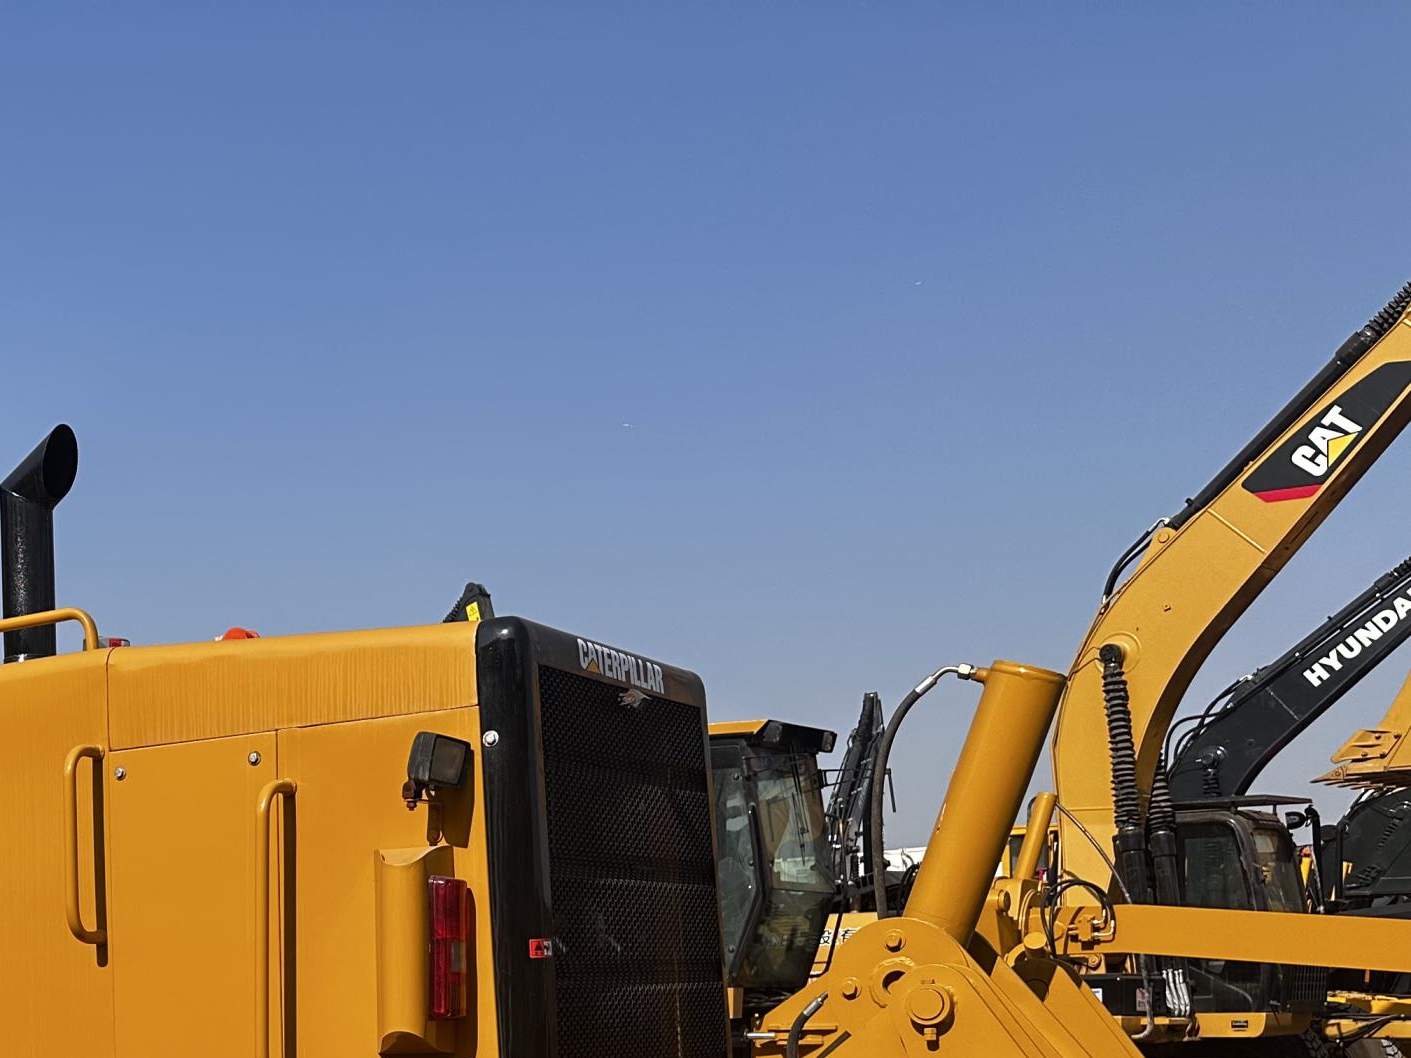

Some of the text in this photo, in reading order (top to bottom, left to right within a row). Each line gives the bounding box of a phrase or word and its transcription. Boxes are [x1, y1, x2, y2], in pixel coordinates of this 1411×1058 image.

[1291, 404, 1363, 477] CAT
[576, 638, 665, 694] CATERPILLAR
[1302, 586, 1411, 687] HYUNDA
